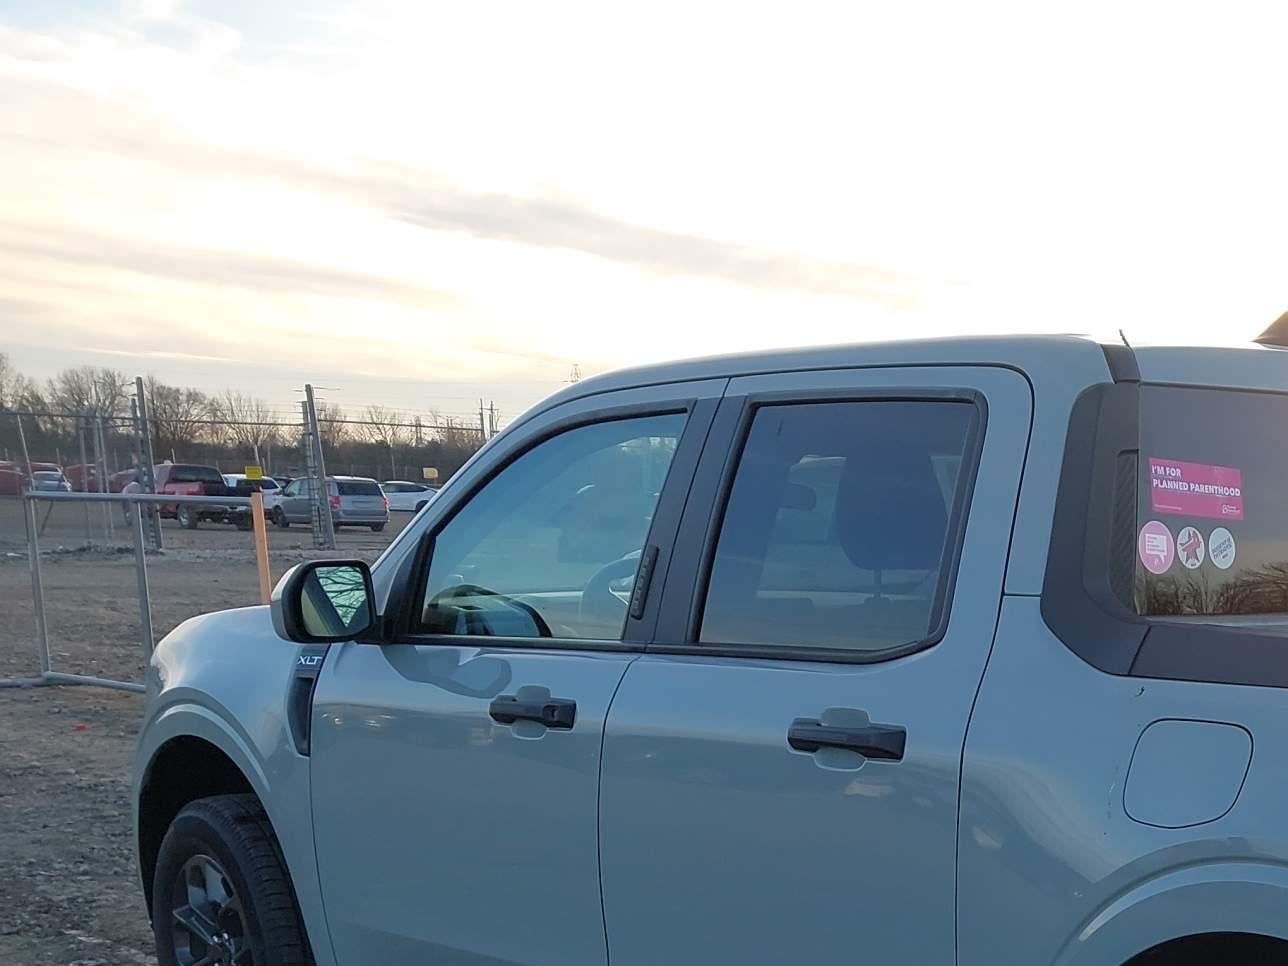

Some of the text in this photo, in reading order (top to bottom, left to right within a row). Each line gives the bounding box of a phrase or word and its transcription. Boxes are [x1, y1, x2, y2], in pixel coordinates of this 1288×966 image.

[1151, 464, 1182, 478] I'M FOR
[1152, 478, 1241, 498] PLANNED PARENTHOOD
[297, 655, 323, 665] XLT
